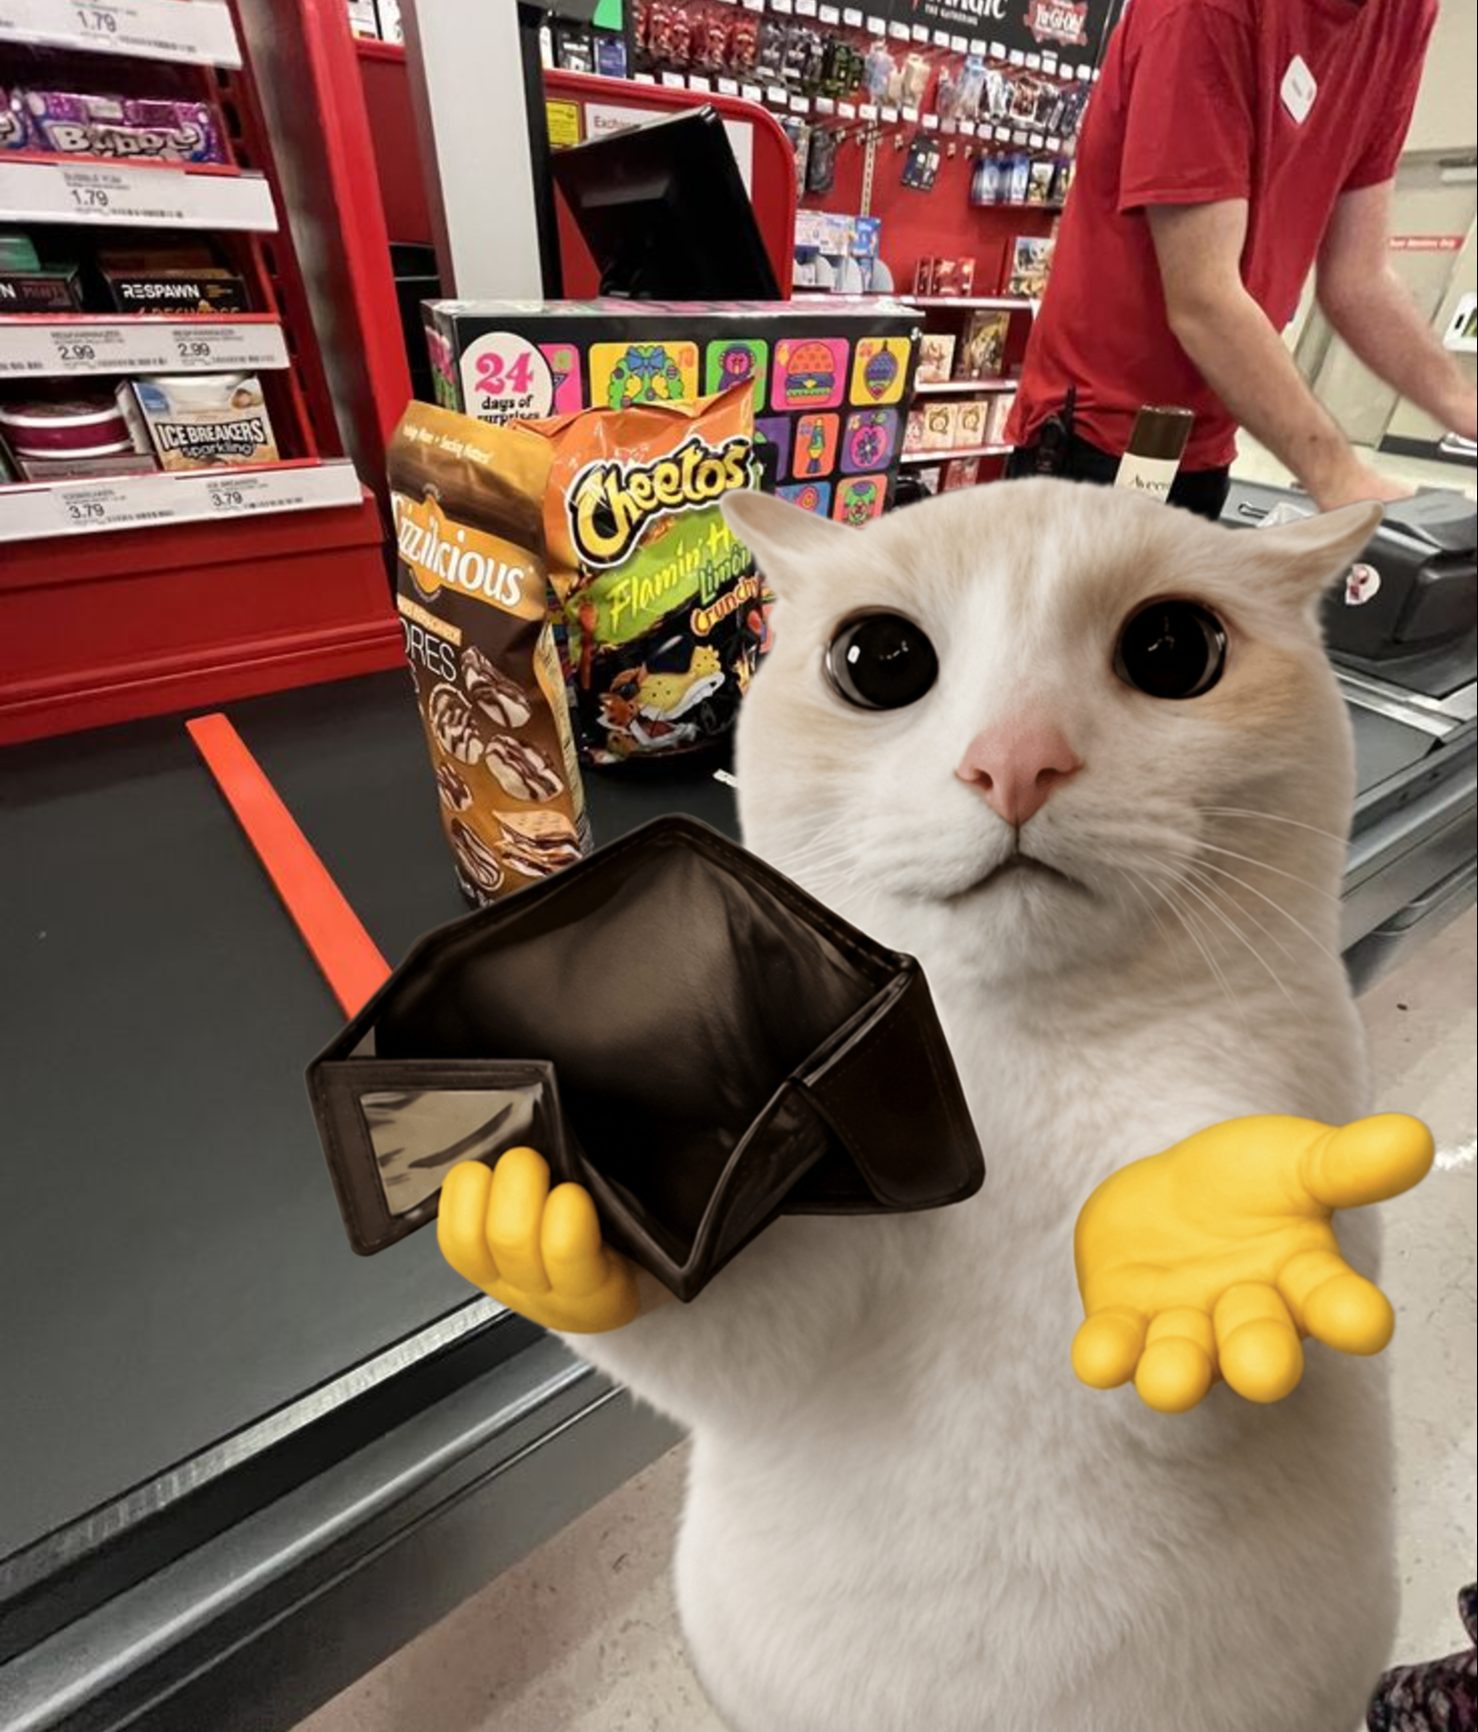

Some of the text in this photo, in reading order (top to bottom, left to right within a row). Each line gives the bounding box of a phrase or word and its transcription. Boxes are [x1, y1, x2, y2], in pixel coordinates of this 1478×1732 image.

[77, 10, 117, 33] 1.79
[72, 189, 109, 207] 1.79
[121, 283, 200, 299] RESPAWN
[57, 345, 95, 360] 2.99
[177, 343, 211, 357] 2.99
[474, 352, 534, 395] 24
[481, 394, 534, 412] days of
[157, 418, 264, 450] ICE BREAKERS
[211, 491, 243, 507] 3.79
[572, 440, 750, 561] Cheetos
[69, 503, 105, 519] 3.79
[605, 537, 703, 634] Flamin'
